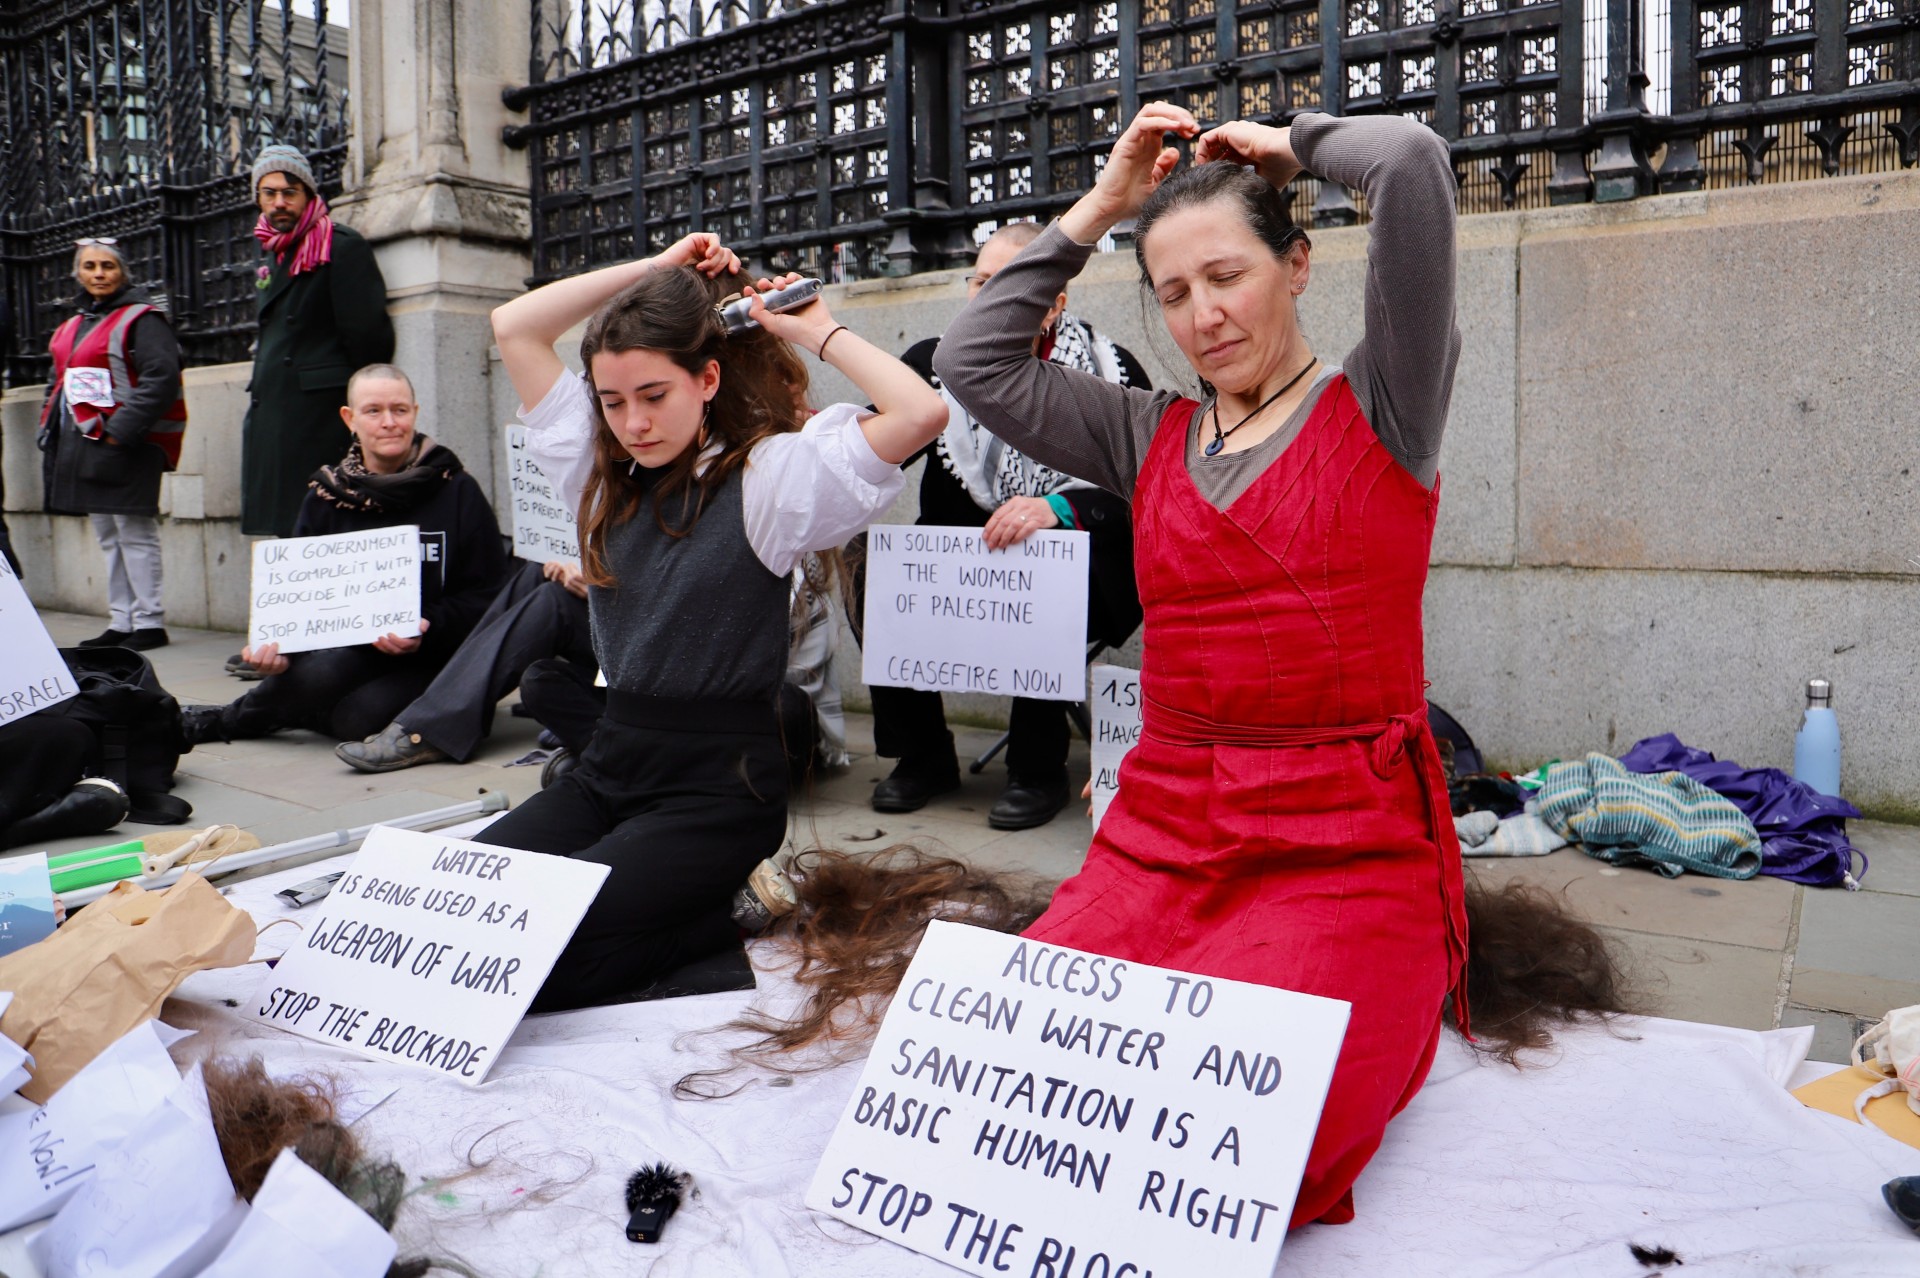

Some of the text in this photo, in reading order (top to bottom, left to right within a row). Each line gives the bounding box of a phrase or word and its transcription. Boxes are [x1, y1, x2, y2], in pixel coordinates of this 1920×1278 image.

[512, 477, 525, 492] TO
[516, 499, 529, 512] TO
[532, 501, 563, 520] PREVENT
[264, 545, 289, 565] UK
[301, 533, 409, 560] GOVERNMENT
[518, 526, 541, 545] STOP
[874, 532, 1075, 561] IN SOLIDARI WITH
[375, 557, 413, 572] WITH
[902, 562, 1033, 592] THE WOMEN
[255, 587, 336, 609] GENOCIDE
[896, 593, 1034, 625] OF PALESTINE
[257, 611, 416, 641] STOP ARMING ISRAEL
[887, 656, 1063, 695] CEASEFIRE NOW
[432, 846, 512, 881] WATER
[339, 874, 530, 932] IS BEING USED AS A
[307, 917, 521, 997] WEAPON OF WAR.
[1001, 941, 1214, 1018] ACCESS TO
[259, 986, 488, 1077] STOP THE BLOCKADE
[907, 977, 1283, 1097] CLEAN WATER AND
[891, 1038, 1241, 1167] SANITATION IS A
[853, 1085, 1280, 1243] BASIC HUMAN RIGHT
[832, 1167, 933, 1234] STOP
[944, 1202, 1024, 1272] THE
